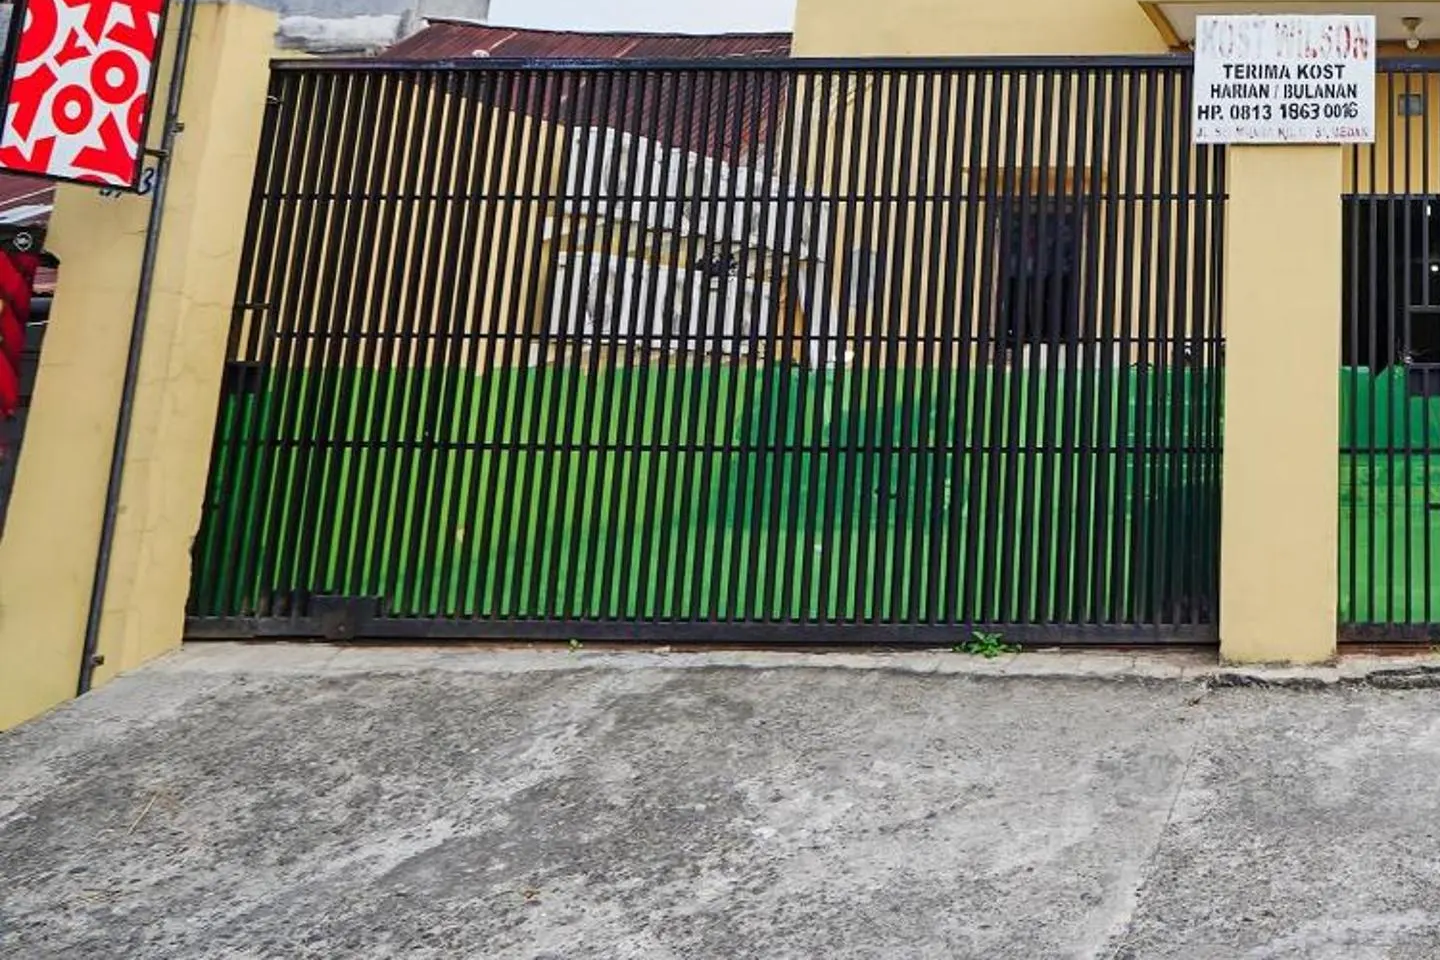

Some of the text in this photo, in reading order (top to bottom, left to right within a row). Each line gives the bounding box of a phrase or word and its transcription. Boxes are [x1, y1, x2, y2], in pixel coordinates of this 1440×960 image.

[1222, 64, 1346, 80] TERIMA KOST
[1210, 83, 1270, 100] HARIAN
[1283, 83, 1358, 100] BULANAN
[1197, 105, 1224, 121] HP.
[1230, 104, 1272, 121] 0813
